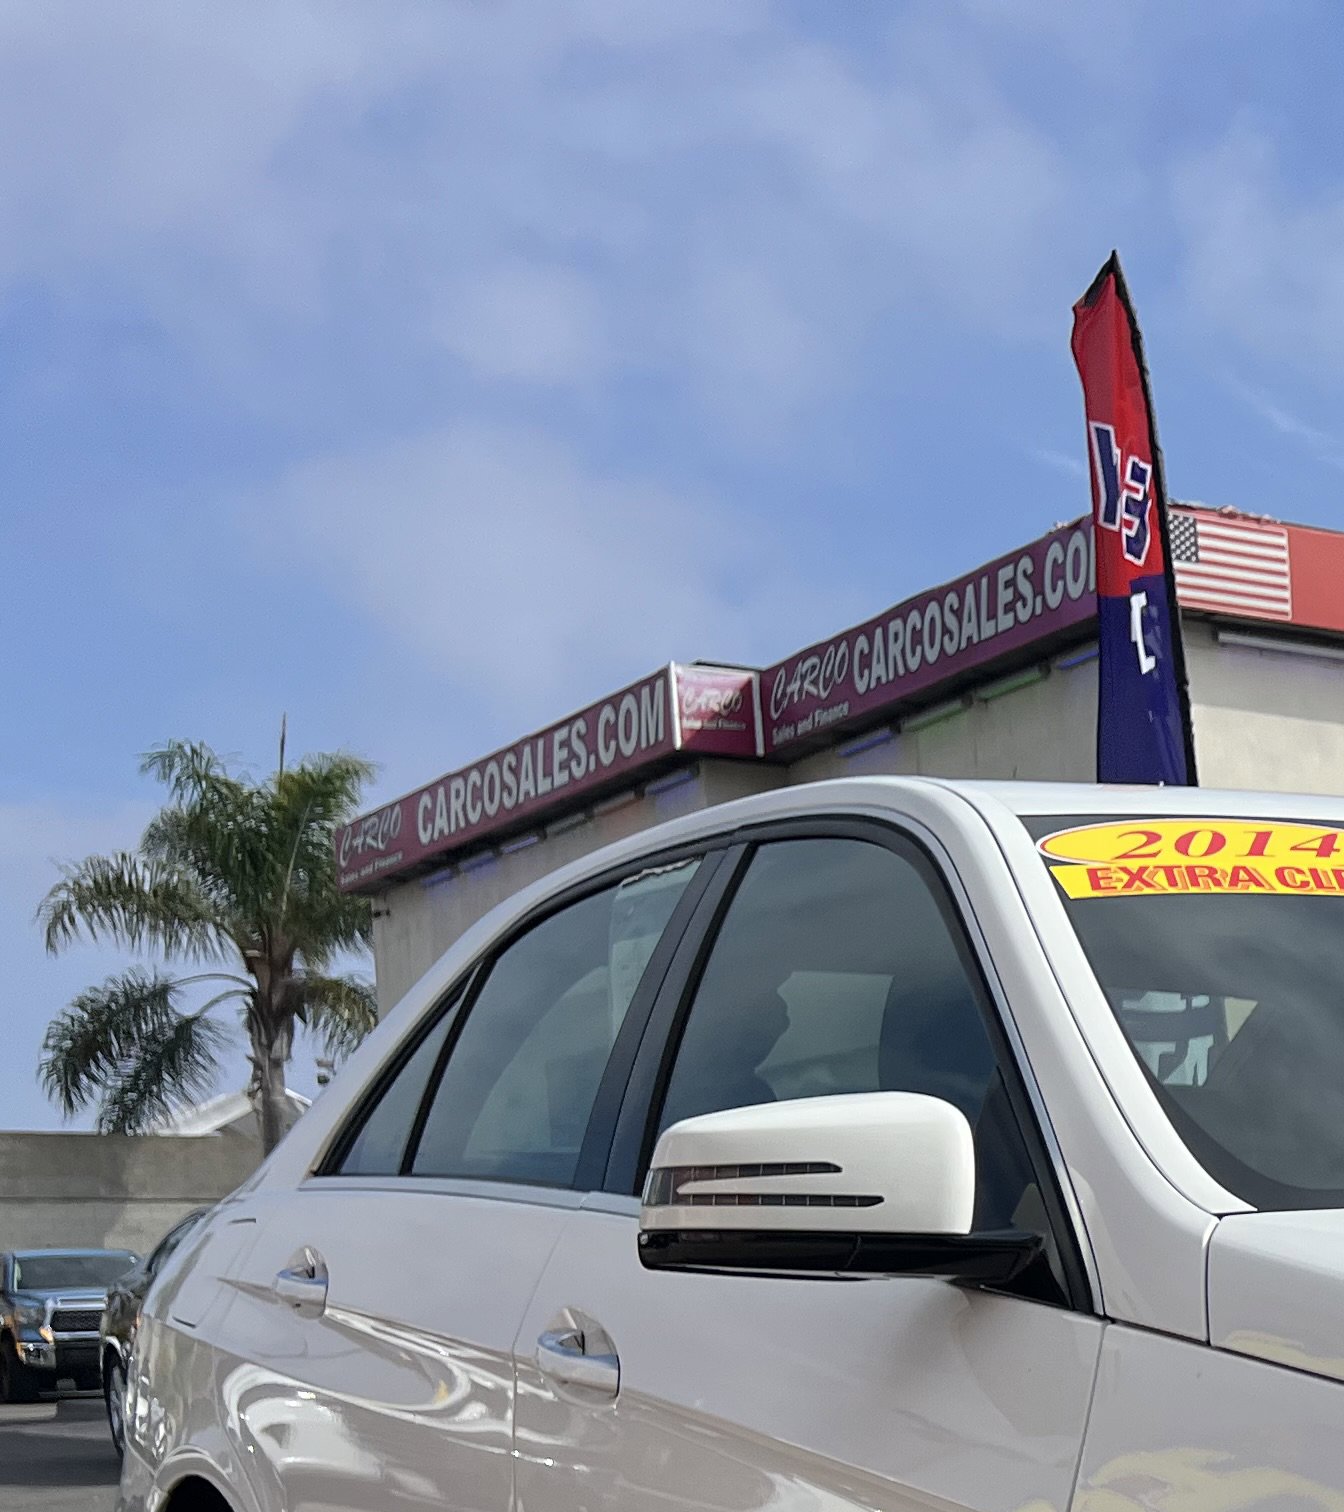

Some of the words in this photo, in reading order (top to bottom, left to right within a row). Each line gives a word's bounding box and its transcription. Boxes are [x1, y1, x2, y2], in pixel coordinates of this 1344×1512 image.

[770, 642, 849, 720] CARCO
[340, 803, 402, 868] CARCO
[417, 676, 664, 846] CARCOSALES.COM
[1112, 830, 1341, 860] 2014
[1086, 865, 1270, 893] EXTRA
